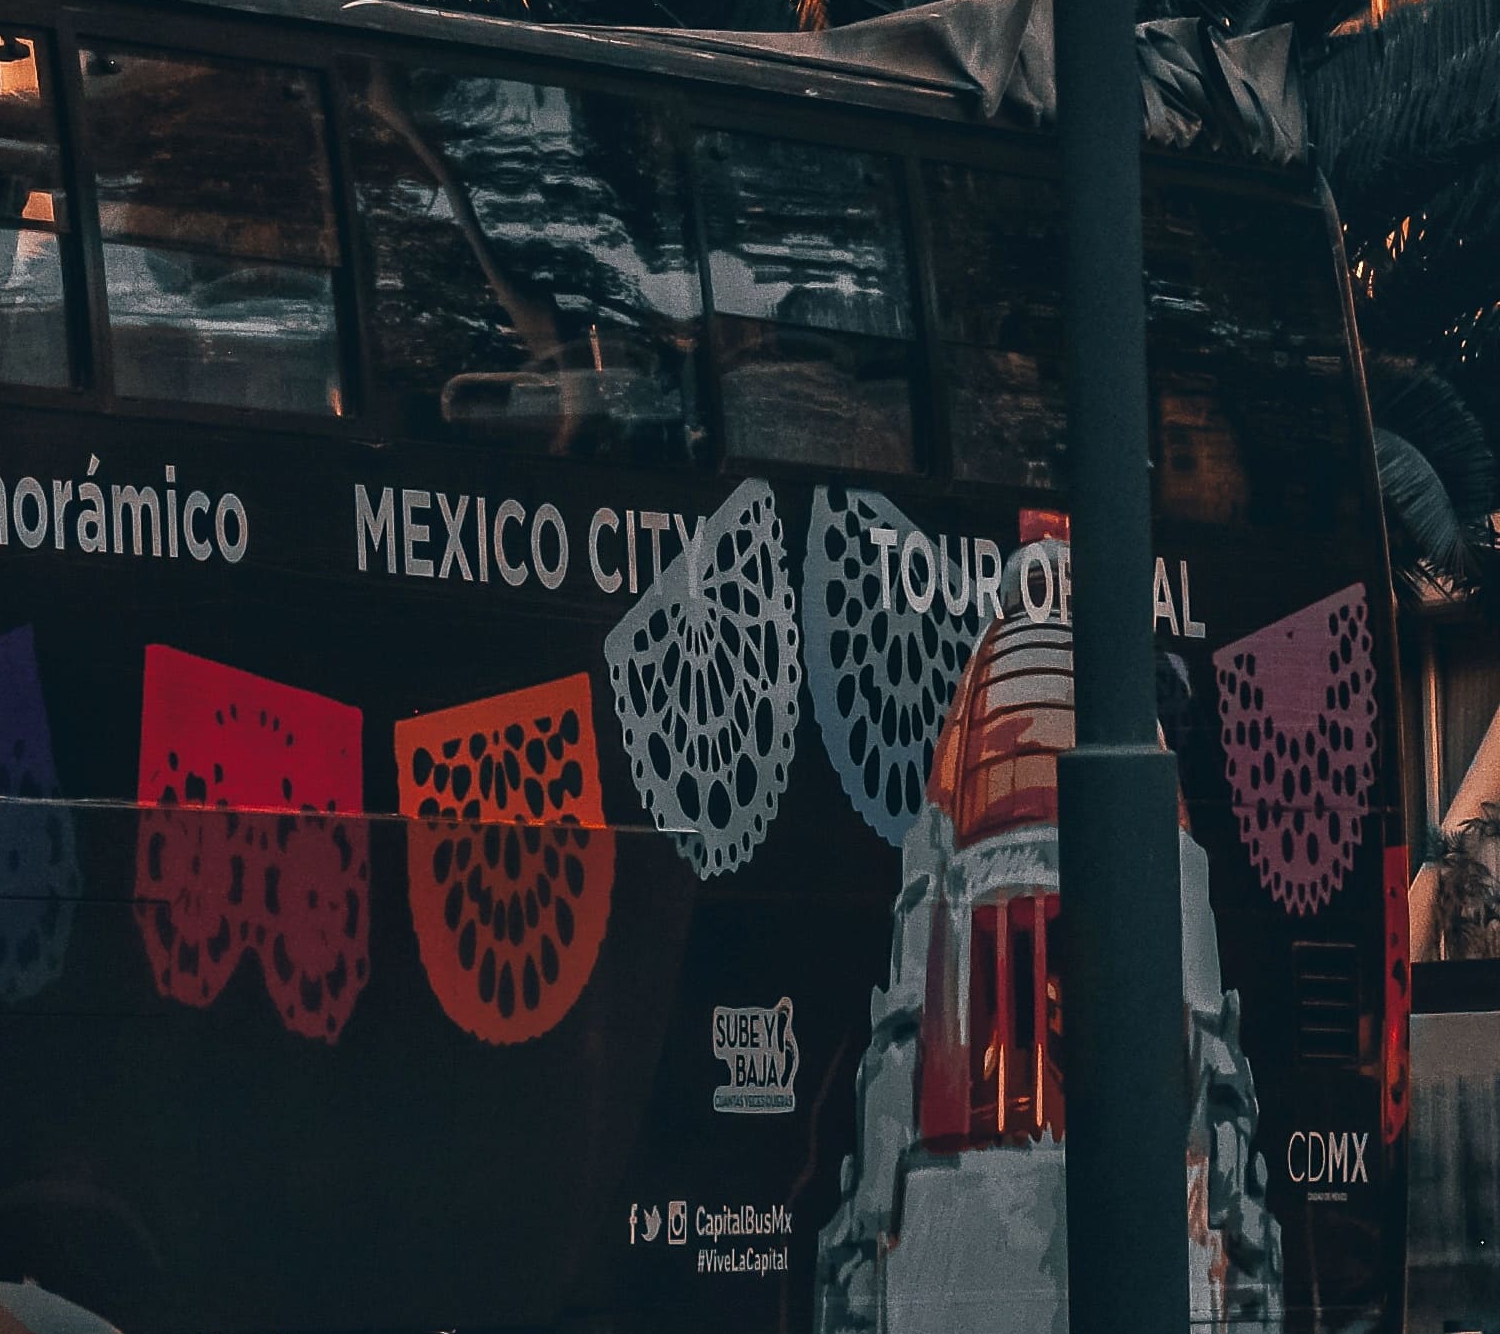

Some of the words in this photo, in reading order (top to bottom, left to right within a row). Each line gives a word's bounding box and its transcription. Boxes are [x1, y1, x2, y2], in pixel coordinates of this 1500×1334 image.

[354, 483, 570, 590] MEXICO
[588, 507, 707, 599] CITY
[869, 526, 1005, 620] TOUR
[716, 1014, 760, 1048] SUBE
[764, 1014, 776, 1048] Y
[736, 1054, 779, 1087] BAJA
[1288, 1131, 1369, 1183] CDMX
[695, 1205, 793, 1242] CapitalBusMx
[697, 1247, 788, 1277] #ViveLaCapital
